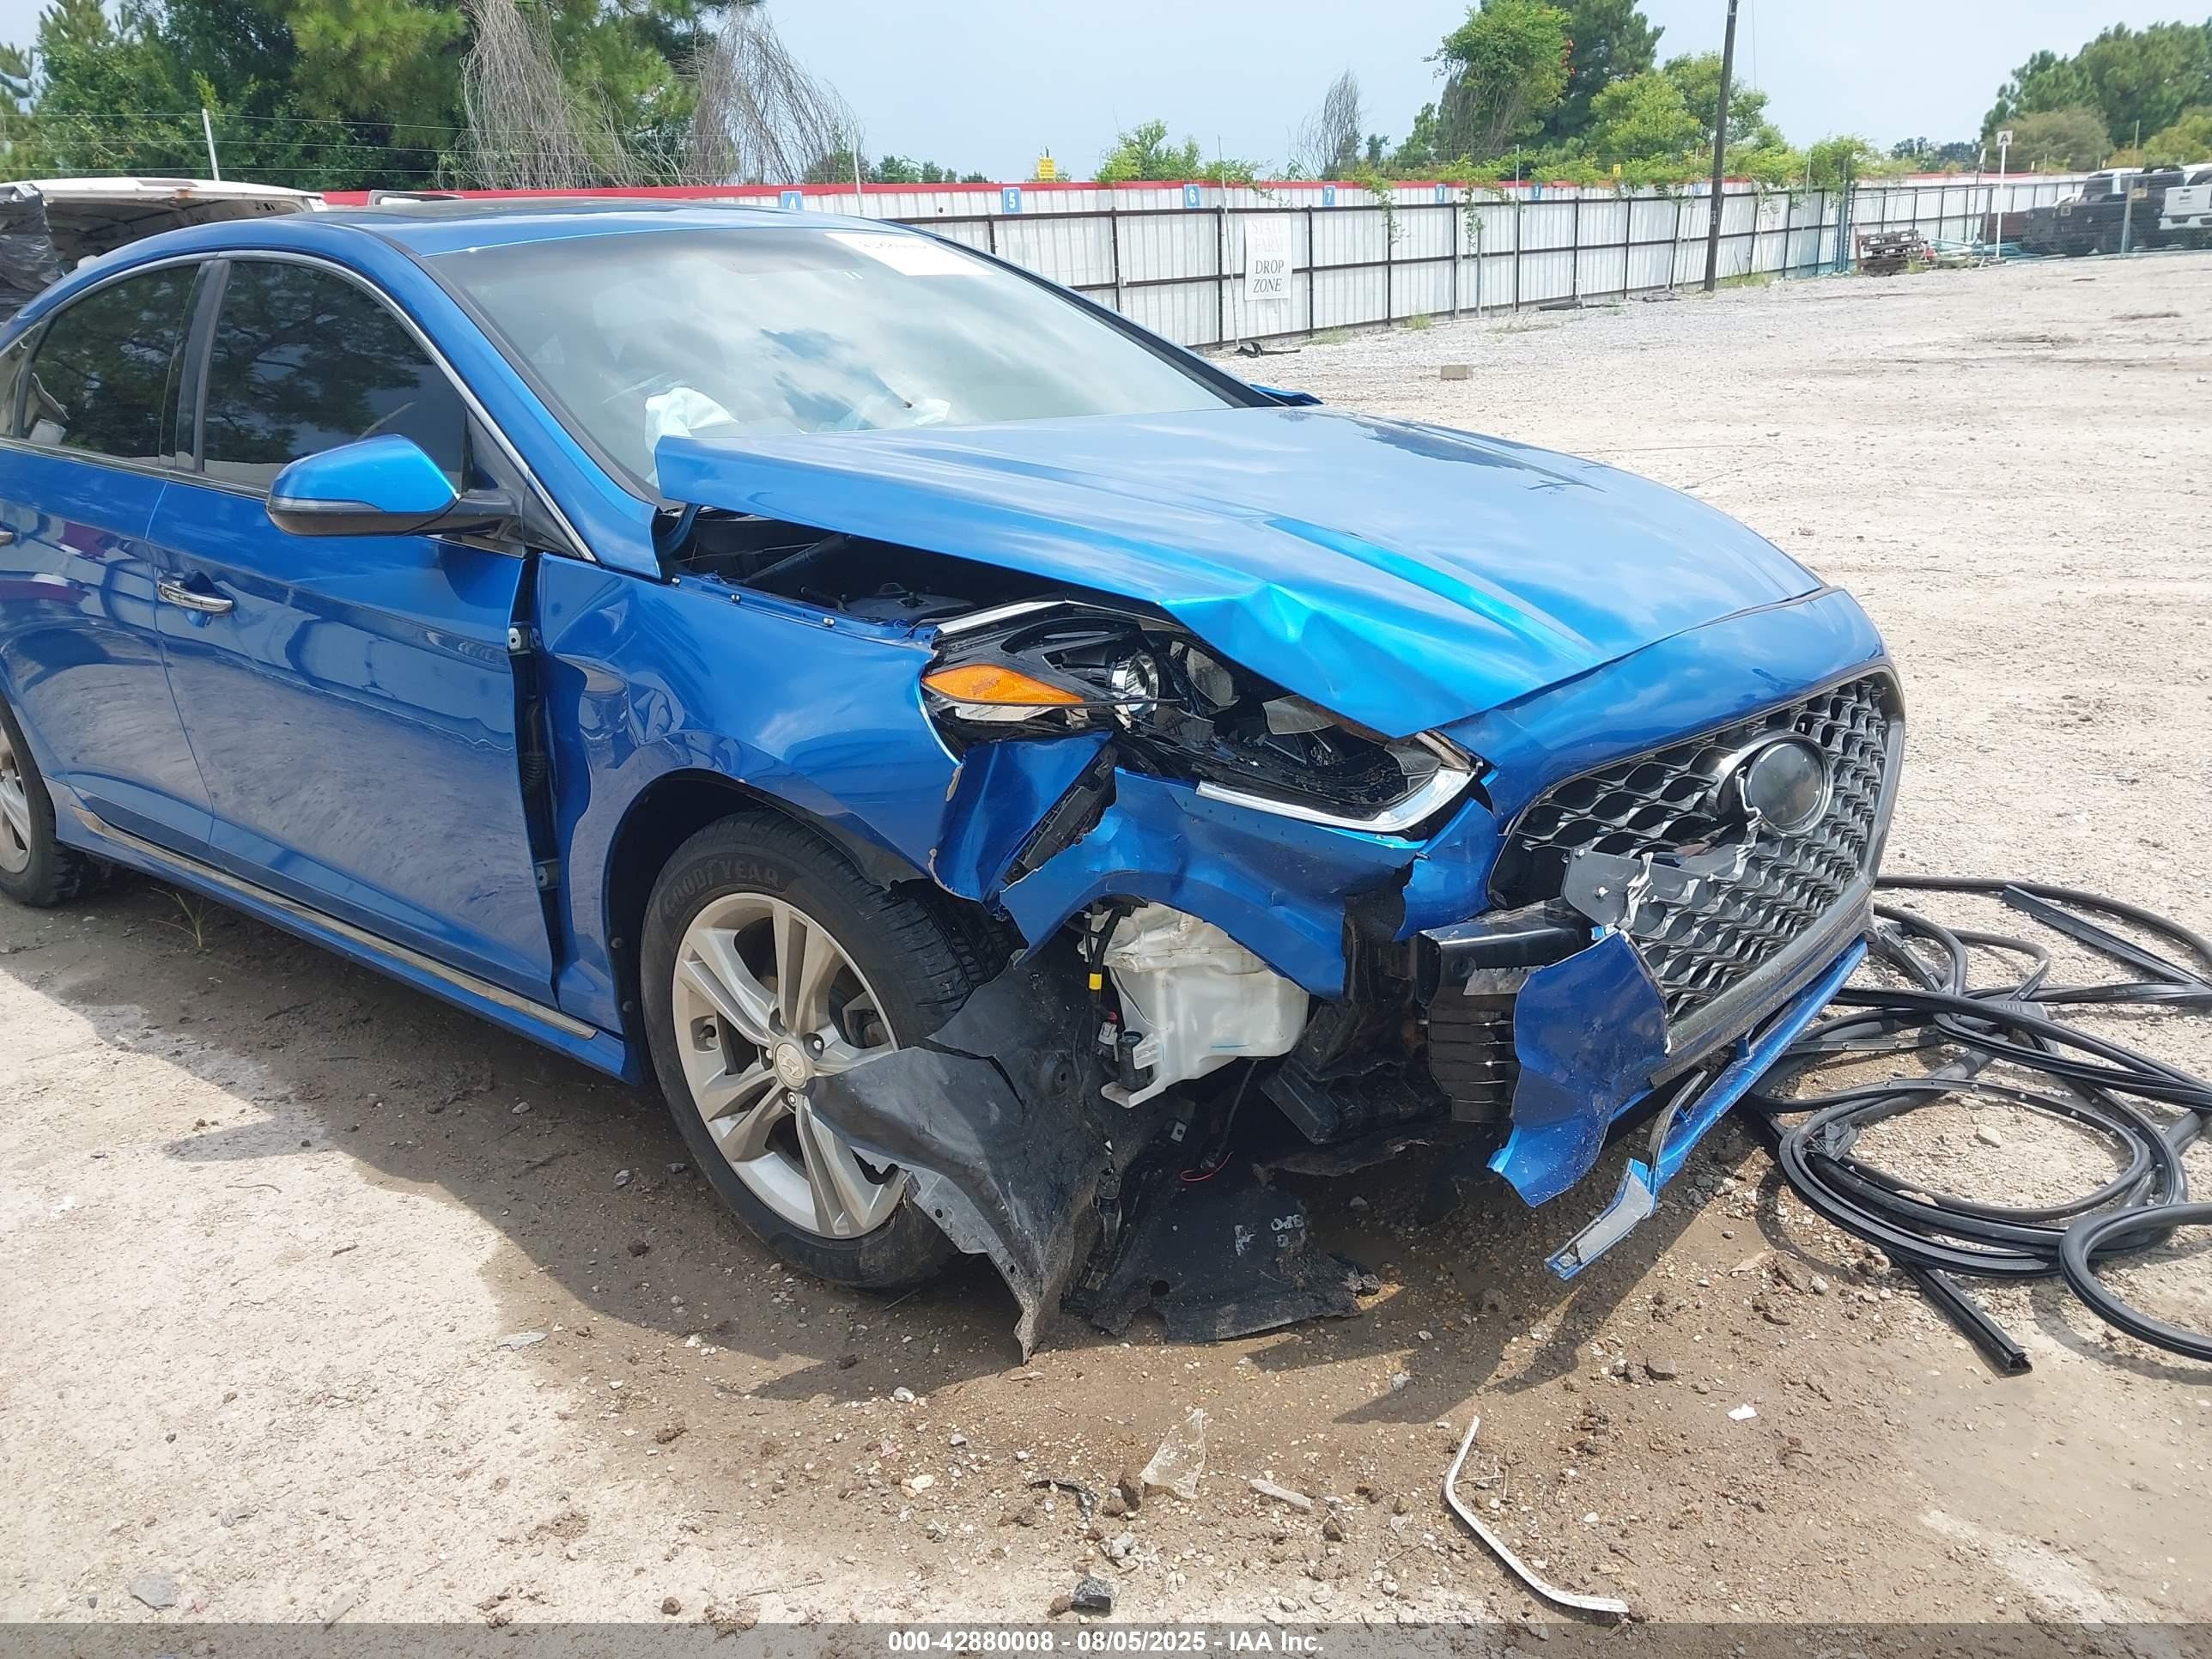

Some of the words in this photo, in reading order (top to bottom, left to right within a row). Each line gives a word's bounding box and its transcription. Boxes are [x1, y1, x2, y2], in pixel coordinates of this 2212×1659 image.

[2000, 133, 2009, 143] A
[1008, 191, 1016, 209] 5
[1189, 189, 1196, 204] 6
[1251, 219, 1285, 234] STATE
[1255, 259, 1285, 275] DROP
[1253, 277, 1283, 293] ZONE
